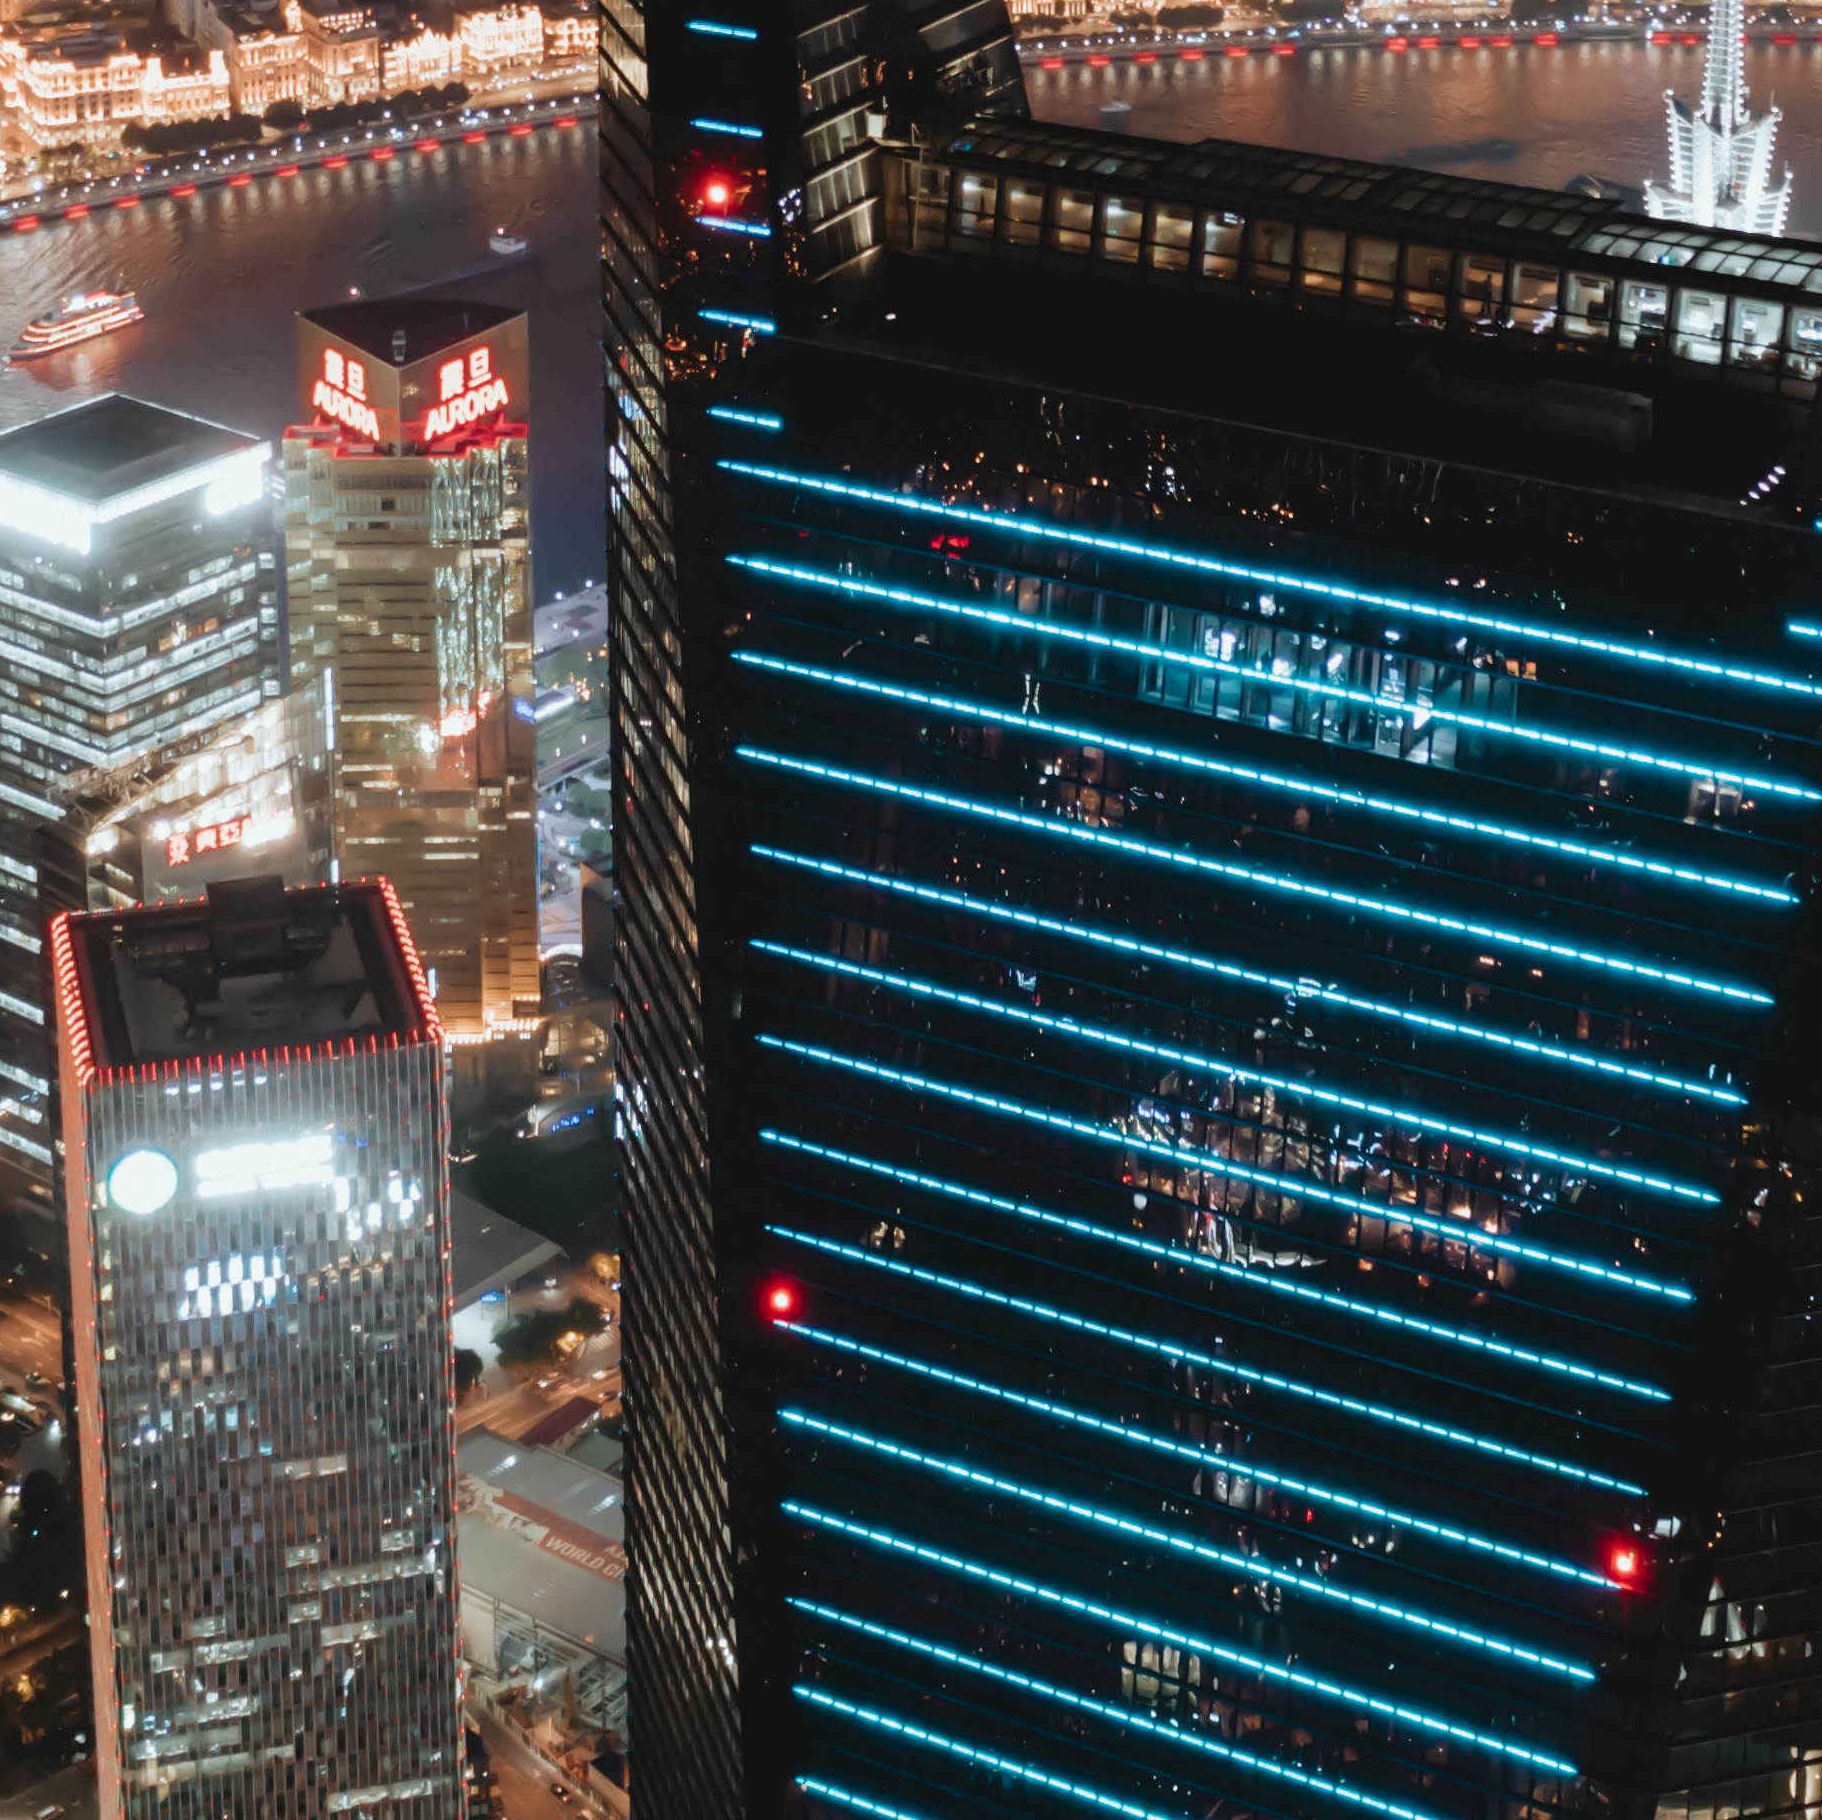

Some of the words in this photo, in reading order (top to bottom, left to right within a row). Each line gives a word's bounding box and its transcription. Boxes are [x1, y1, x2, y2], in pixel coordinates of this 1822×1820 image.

[312, 380, 381, 442] AURORA
[423, 378, 510, 442] AURORA
[546, 1536, 605, 1569] WORLD
